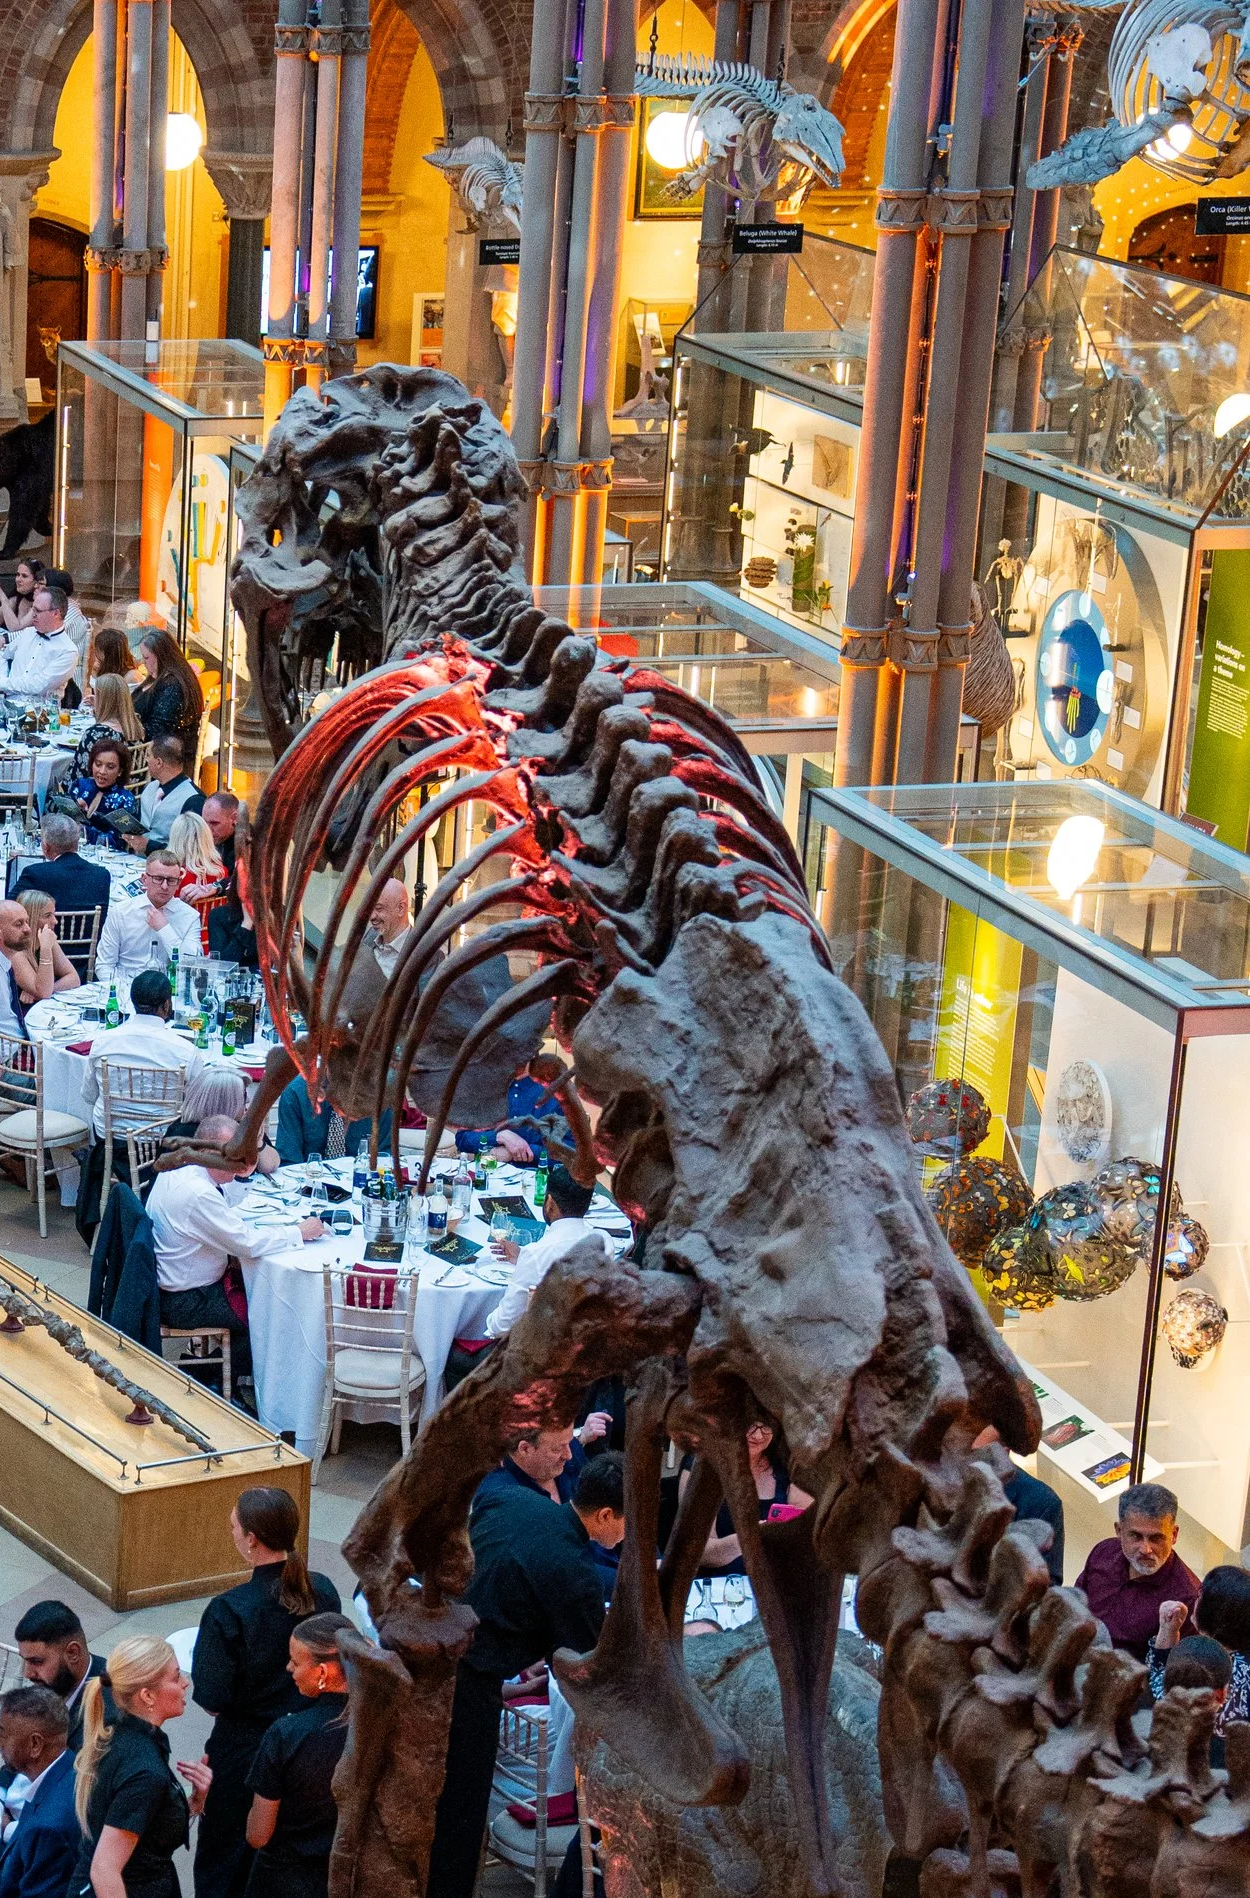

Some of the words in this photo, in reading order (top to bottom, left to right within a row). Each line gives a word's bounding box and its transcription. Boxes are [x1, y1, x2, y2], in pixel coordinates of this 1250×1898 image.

[1227, 205, 1247, 213] (Killer
[2, 832, 9, 844] 7
[414, 1162, 422, 1177] 3
